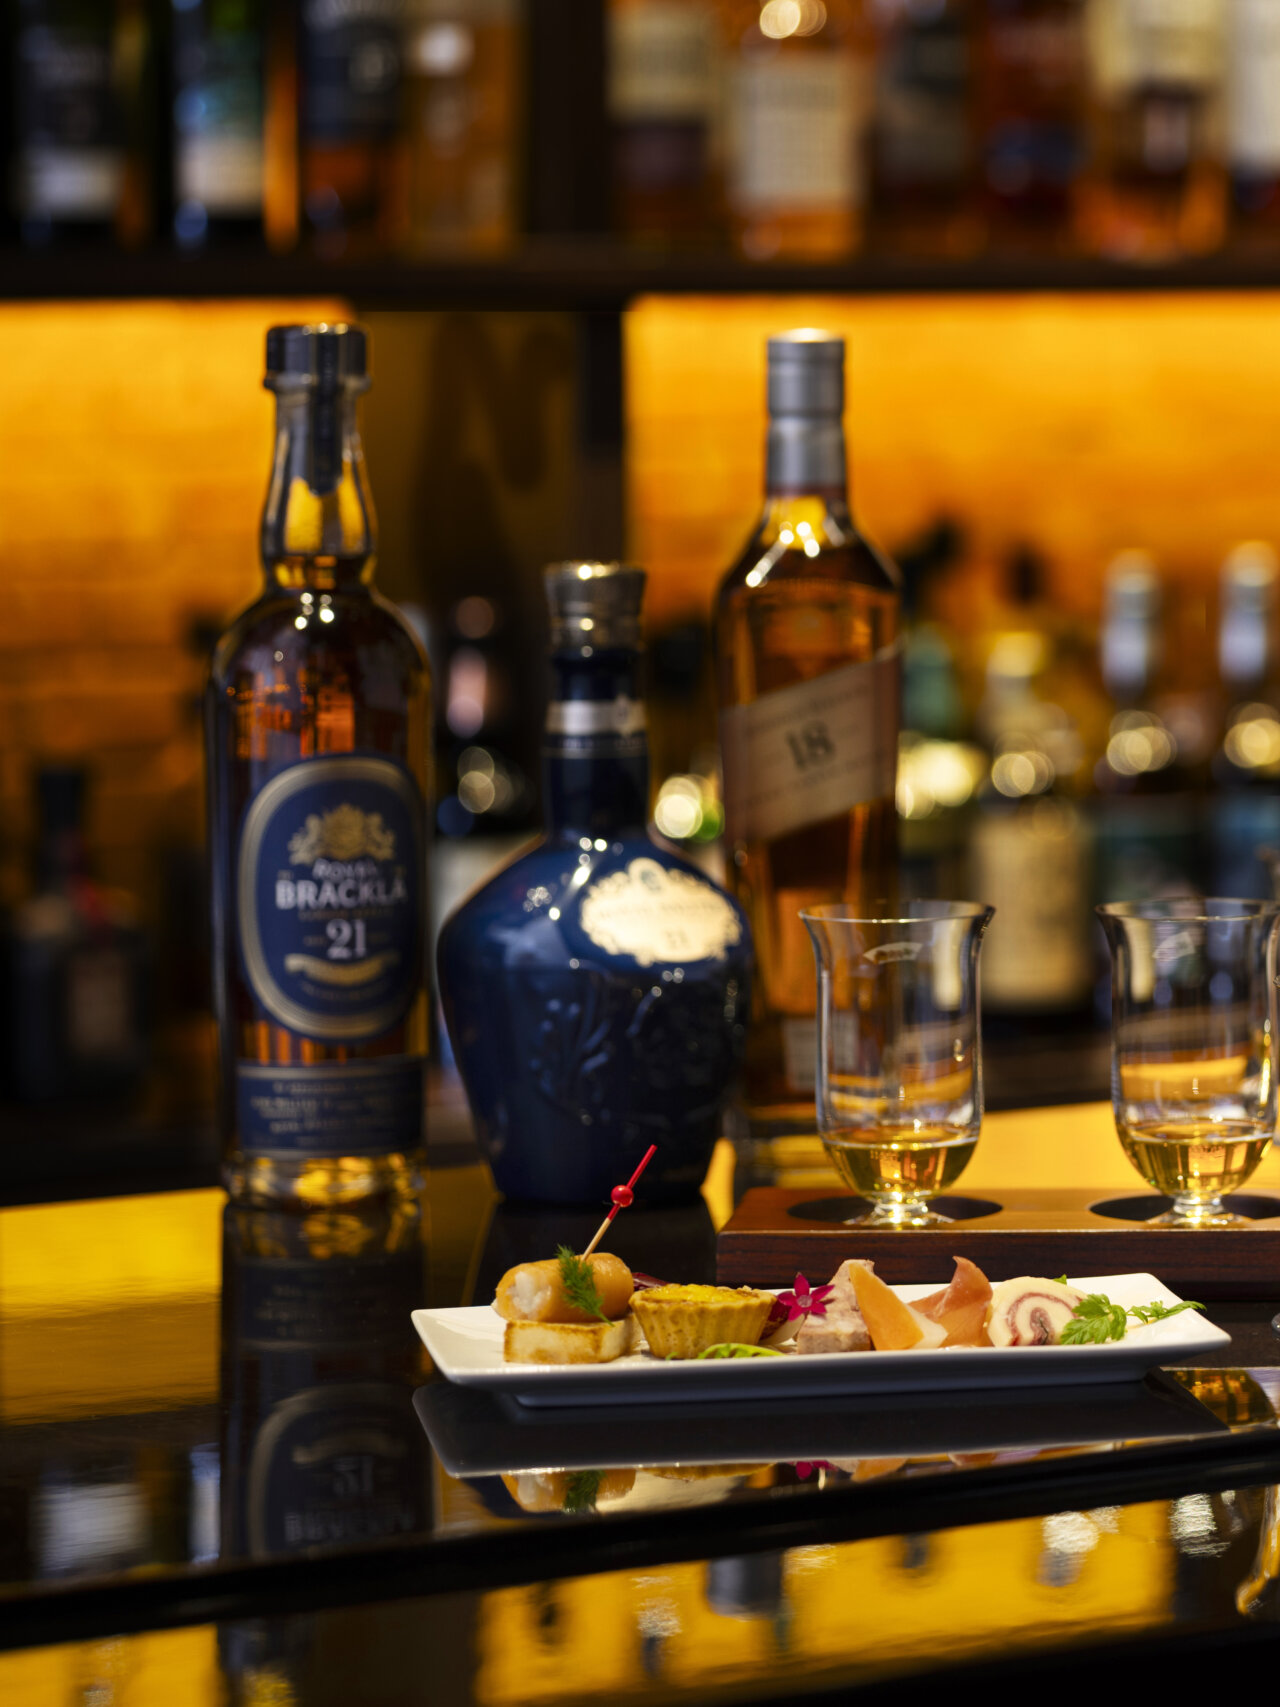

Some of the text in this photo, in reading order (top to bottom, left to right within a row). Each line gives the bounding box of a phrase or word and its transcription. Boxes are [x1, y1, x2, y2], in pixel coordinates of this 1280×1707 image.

[785, 720, 836, 772] 18
[275, 877, 407, 910] BRACKLA
[325, 919, 367, 959] 21
